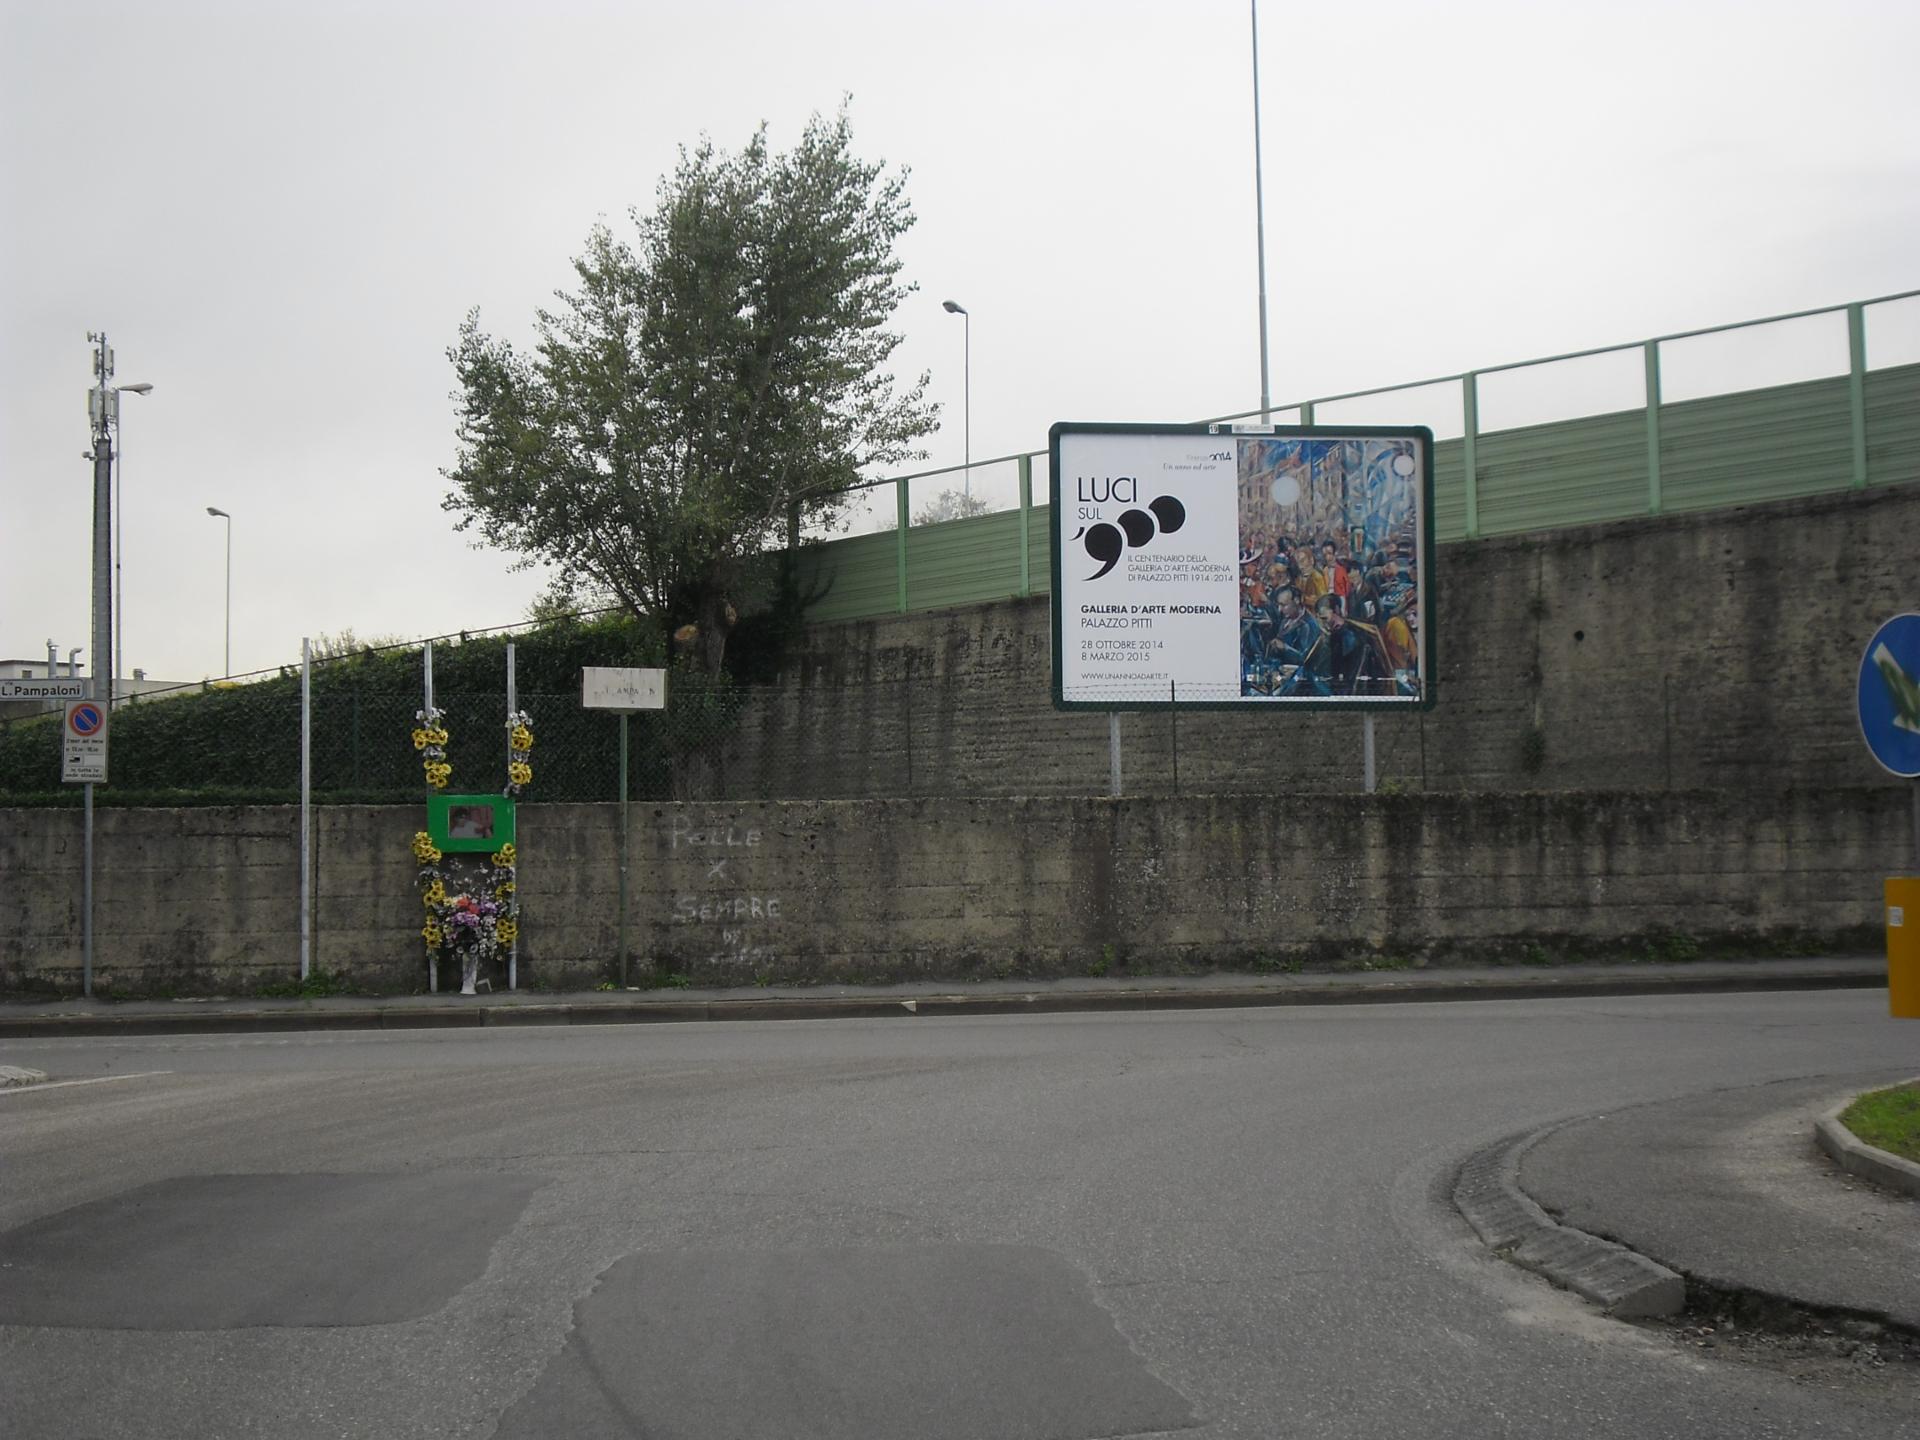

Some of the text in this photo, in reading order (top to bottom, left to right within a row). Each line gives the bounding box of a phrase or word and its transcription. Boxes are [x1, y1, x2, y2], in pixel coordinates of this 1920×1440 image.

[1078, 477, 1137, 503] LUCI
[1078, 507, 1102, 520] SUL
[1128, 554, 1208, 563] IL CENTENARIO DELLA
[1128, 564, 1231, 573] GALLERIA D'ARTE MODERNA
[1128, 574, 1136, 582] DI
[1137, 574, 1172, 582] PALAZZO
[1173, 574, 1189, 582] PITTI
[1081, 605, 1222, 614] GALLERIA D'ARTE MODERNA
[1081, 618, 1153, 628] PALAZZO PITTI
[1081, 640, 1164, 649] 28 OTTOBRE 2014
[1081, 652, 1150, 661] 8 MARZO 2015
[2, 685, 80, 697] L. Pampaloni
[671, 896, 781, 923] SEMPRE
